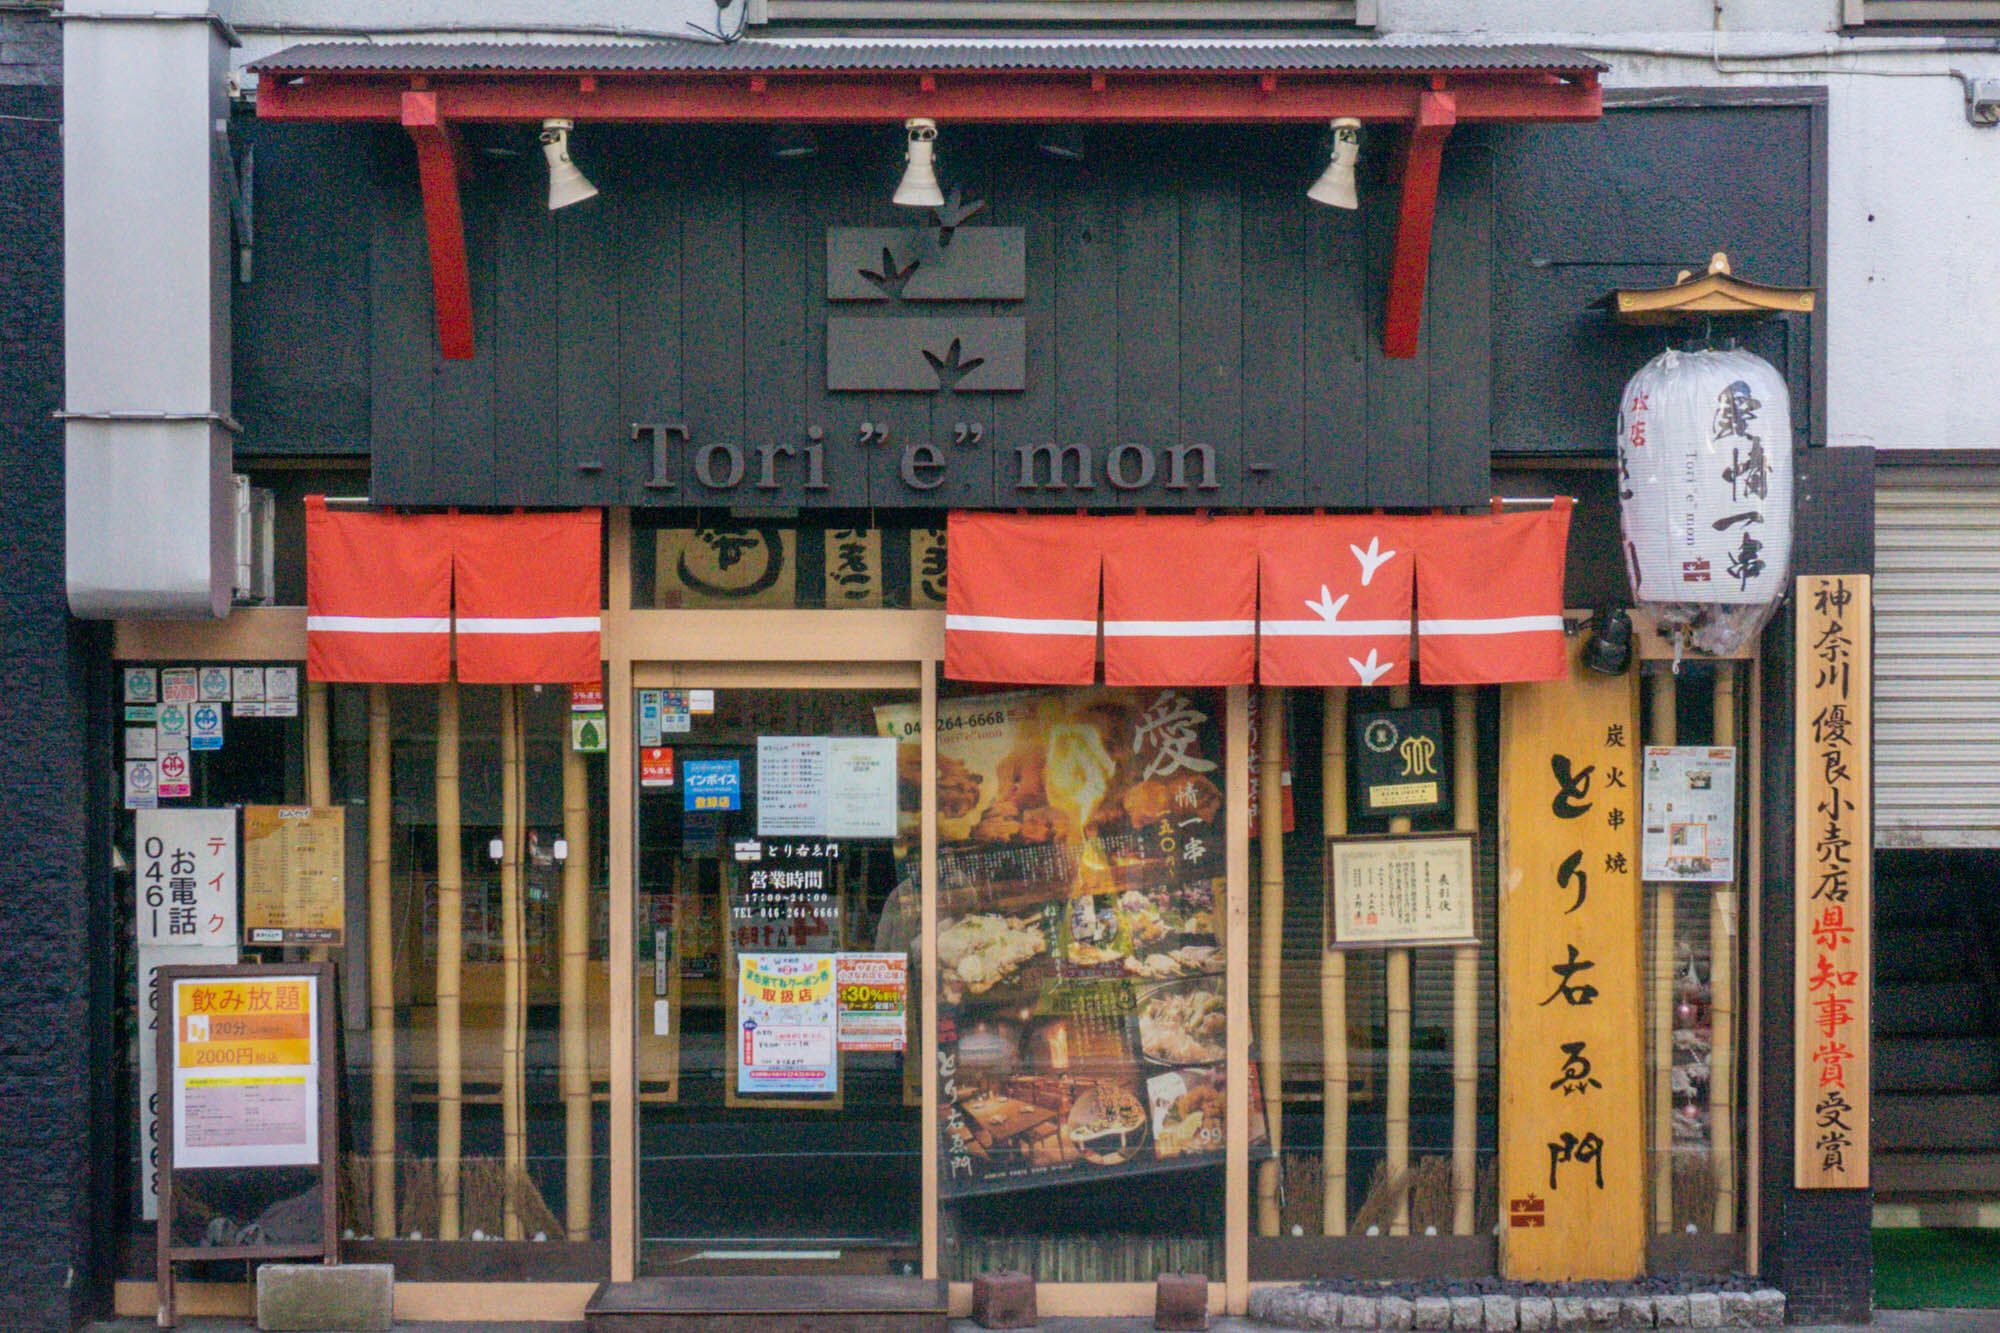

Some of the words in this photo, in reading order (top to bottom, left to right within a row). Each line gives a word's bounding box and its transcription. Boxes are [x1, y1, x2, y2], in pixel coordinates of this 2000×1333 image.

[632, 422, 829, 490] Tori
[1015, 441, 1222, 491] mon
[686, 773, 738, 786] インボイス
[1605, 723, 1628, 875] 炭火串焼
[207, 837, 227, 934] テイク
[750, 869, 823, 890] 営業時間
[169, 848, 197, 937] お電話
[733, 908, 753, 919] TEL
[191, 985, 301, 1012] 飲み放題
[762, 987, 813, 1003] 取扱店
[196, 1047, 254, 1064] 2000円
